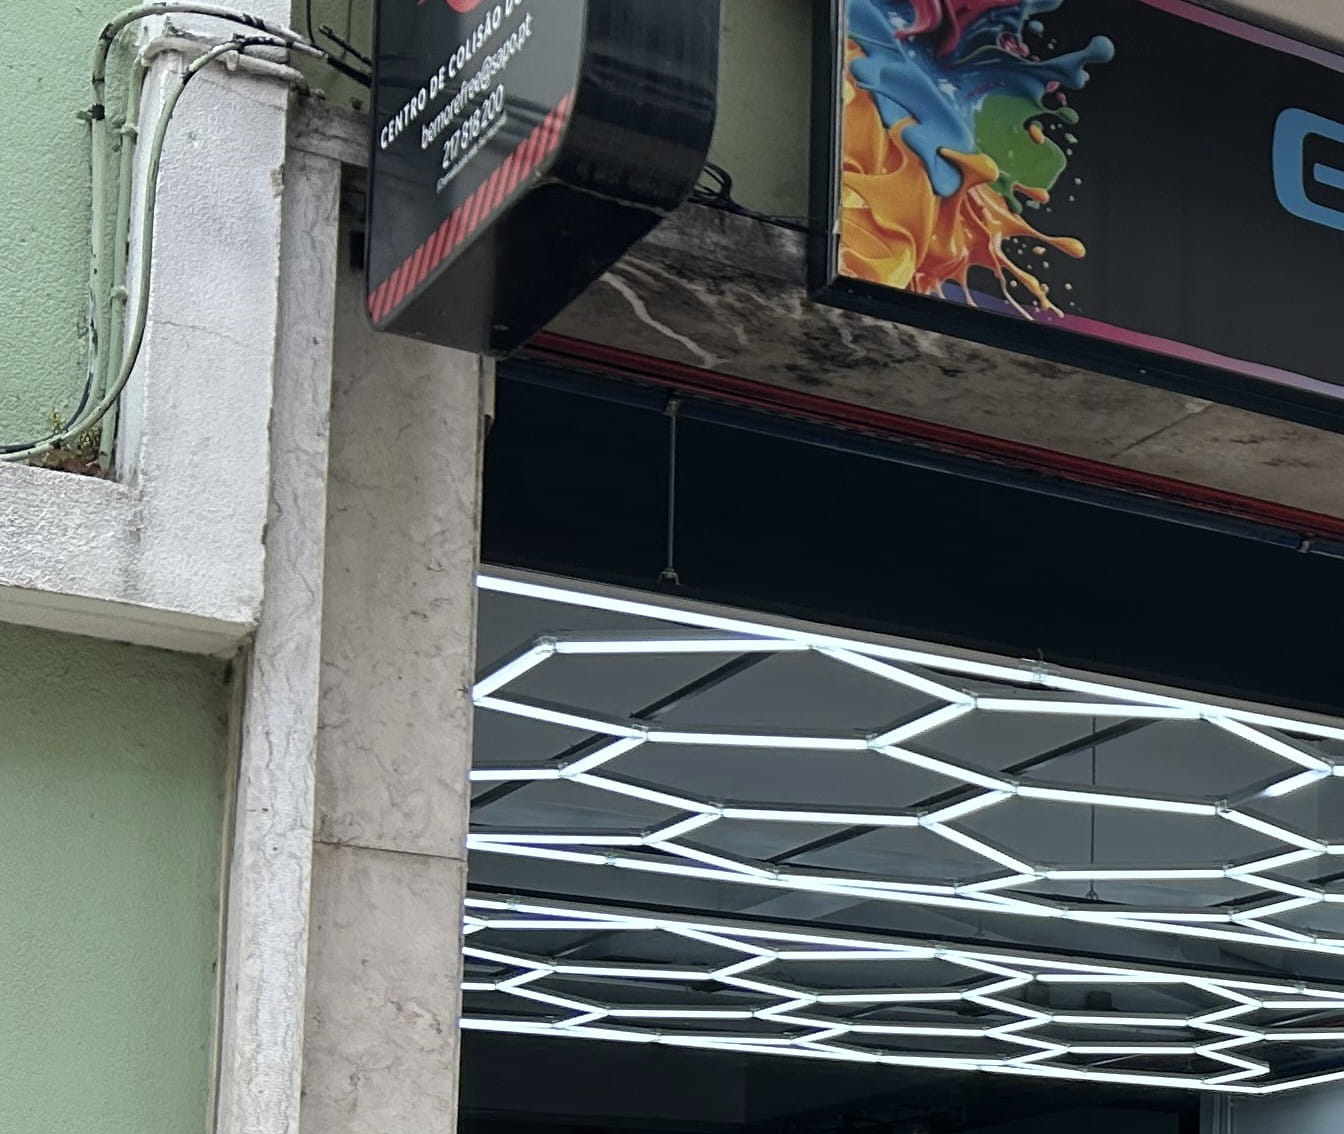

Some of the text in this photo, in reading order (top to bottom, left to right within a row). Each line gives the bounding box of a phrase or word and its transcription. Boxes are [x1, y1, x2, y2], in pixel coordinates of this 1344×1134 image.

[380, 87, 426, 149] CENTRO
[430, 65, 447, 99] DE
[448, 5, 501, 78] COLISÃO
